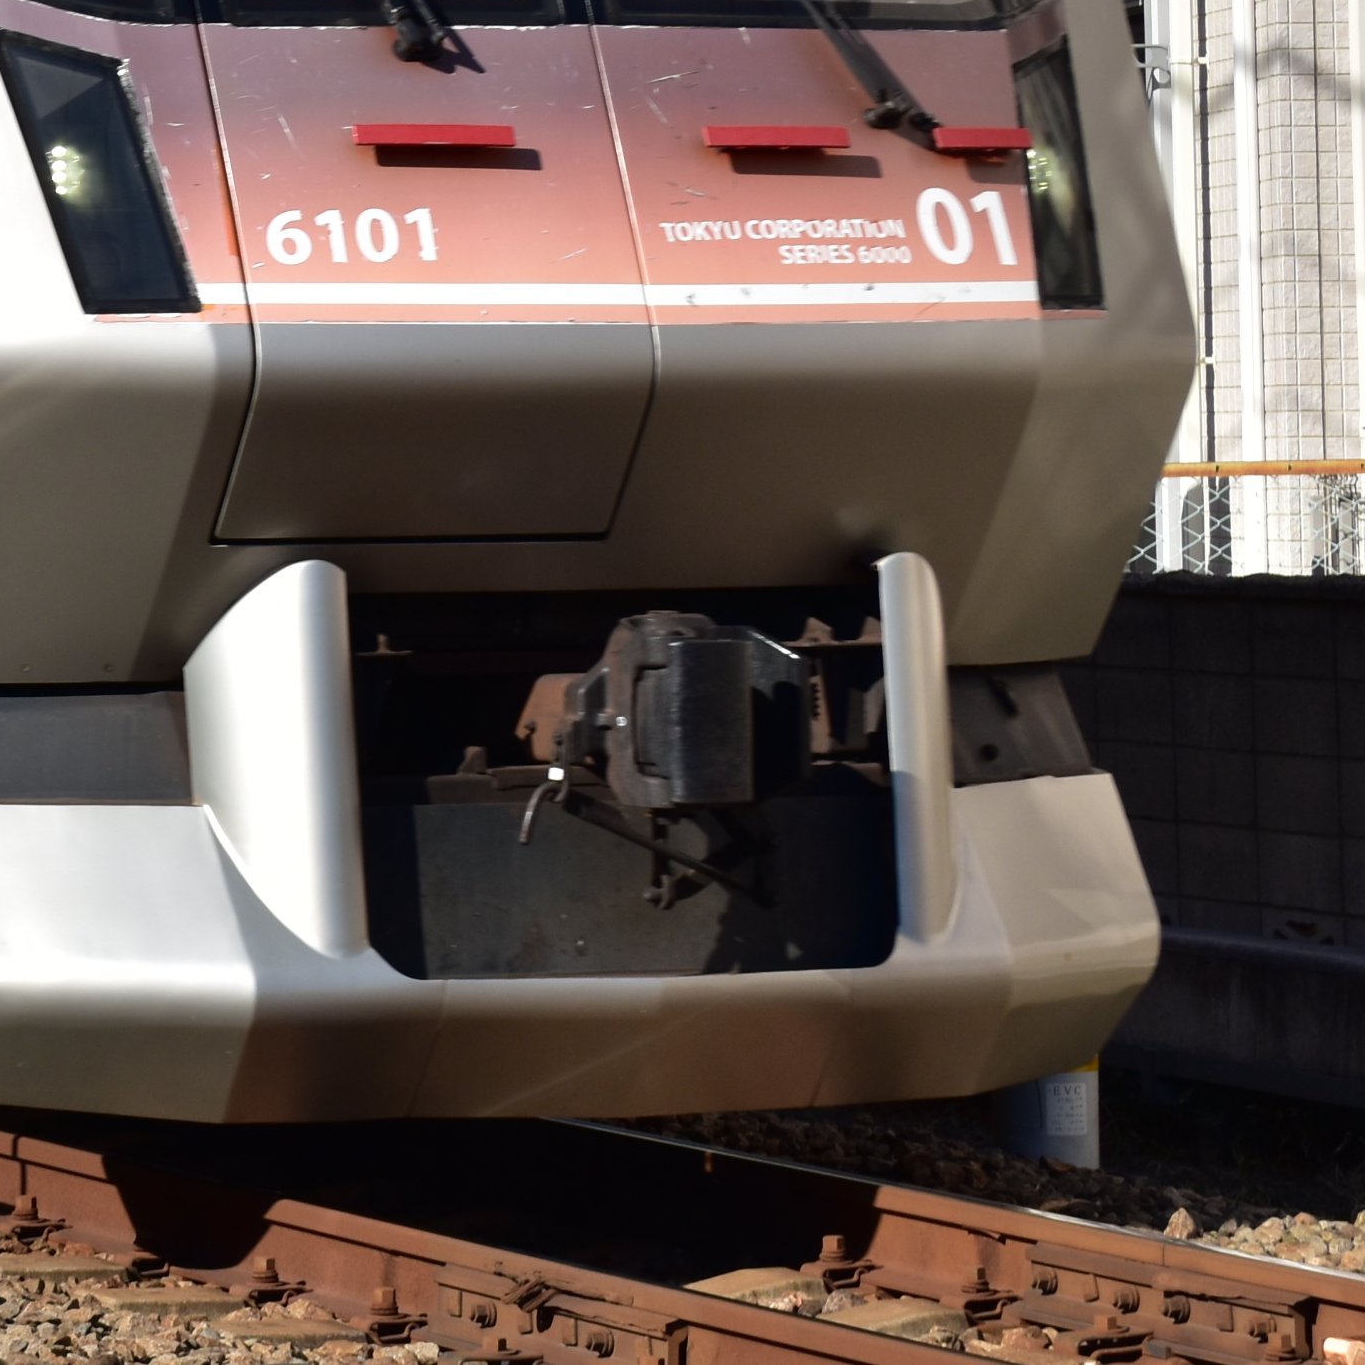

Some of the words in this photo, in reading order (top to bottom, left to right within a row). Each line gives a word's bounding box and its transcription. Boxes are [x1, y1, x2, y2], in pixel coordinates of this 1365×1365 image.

[265, 207, 438, 266] 6101
[659, 220, 743, 242] TOKYU
[744, 218, 907, 240] CORPORATION
[915, 186, 1018, 266] 01
[777, 244, 856, 265] SERIES
[857, 245, 912, 265] 6000
